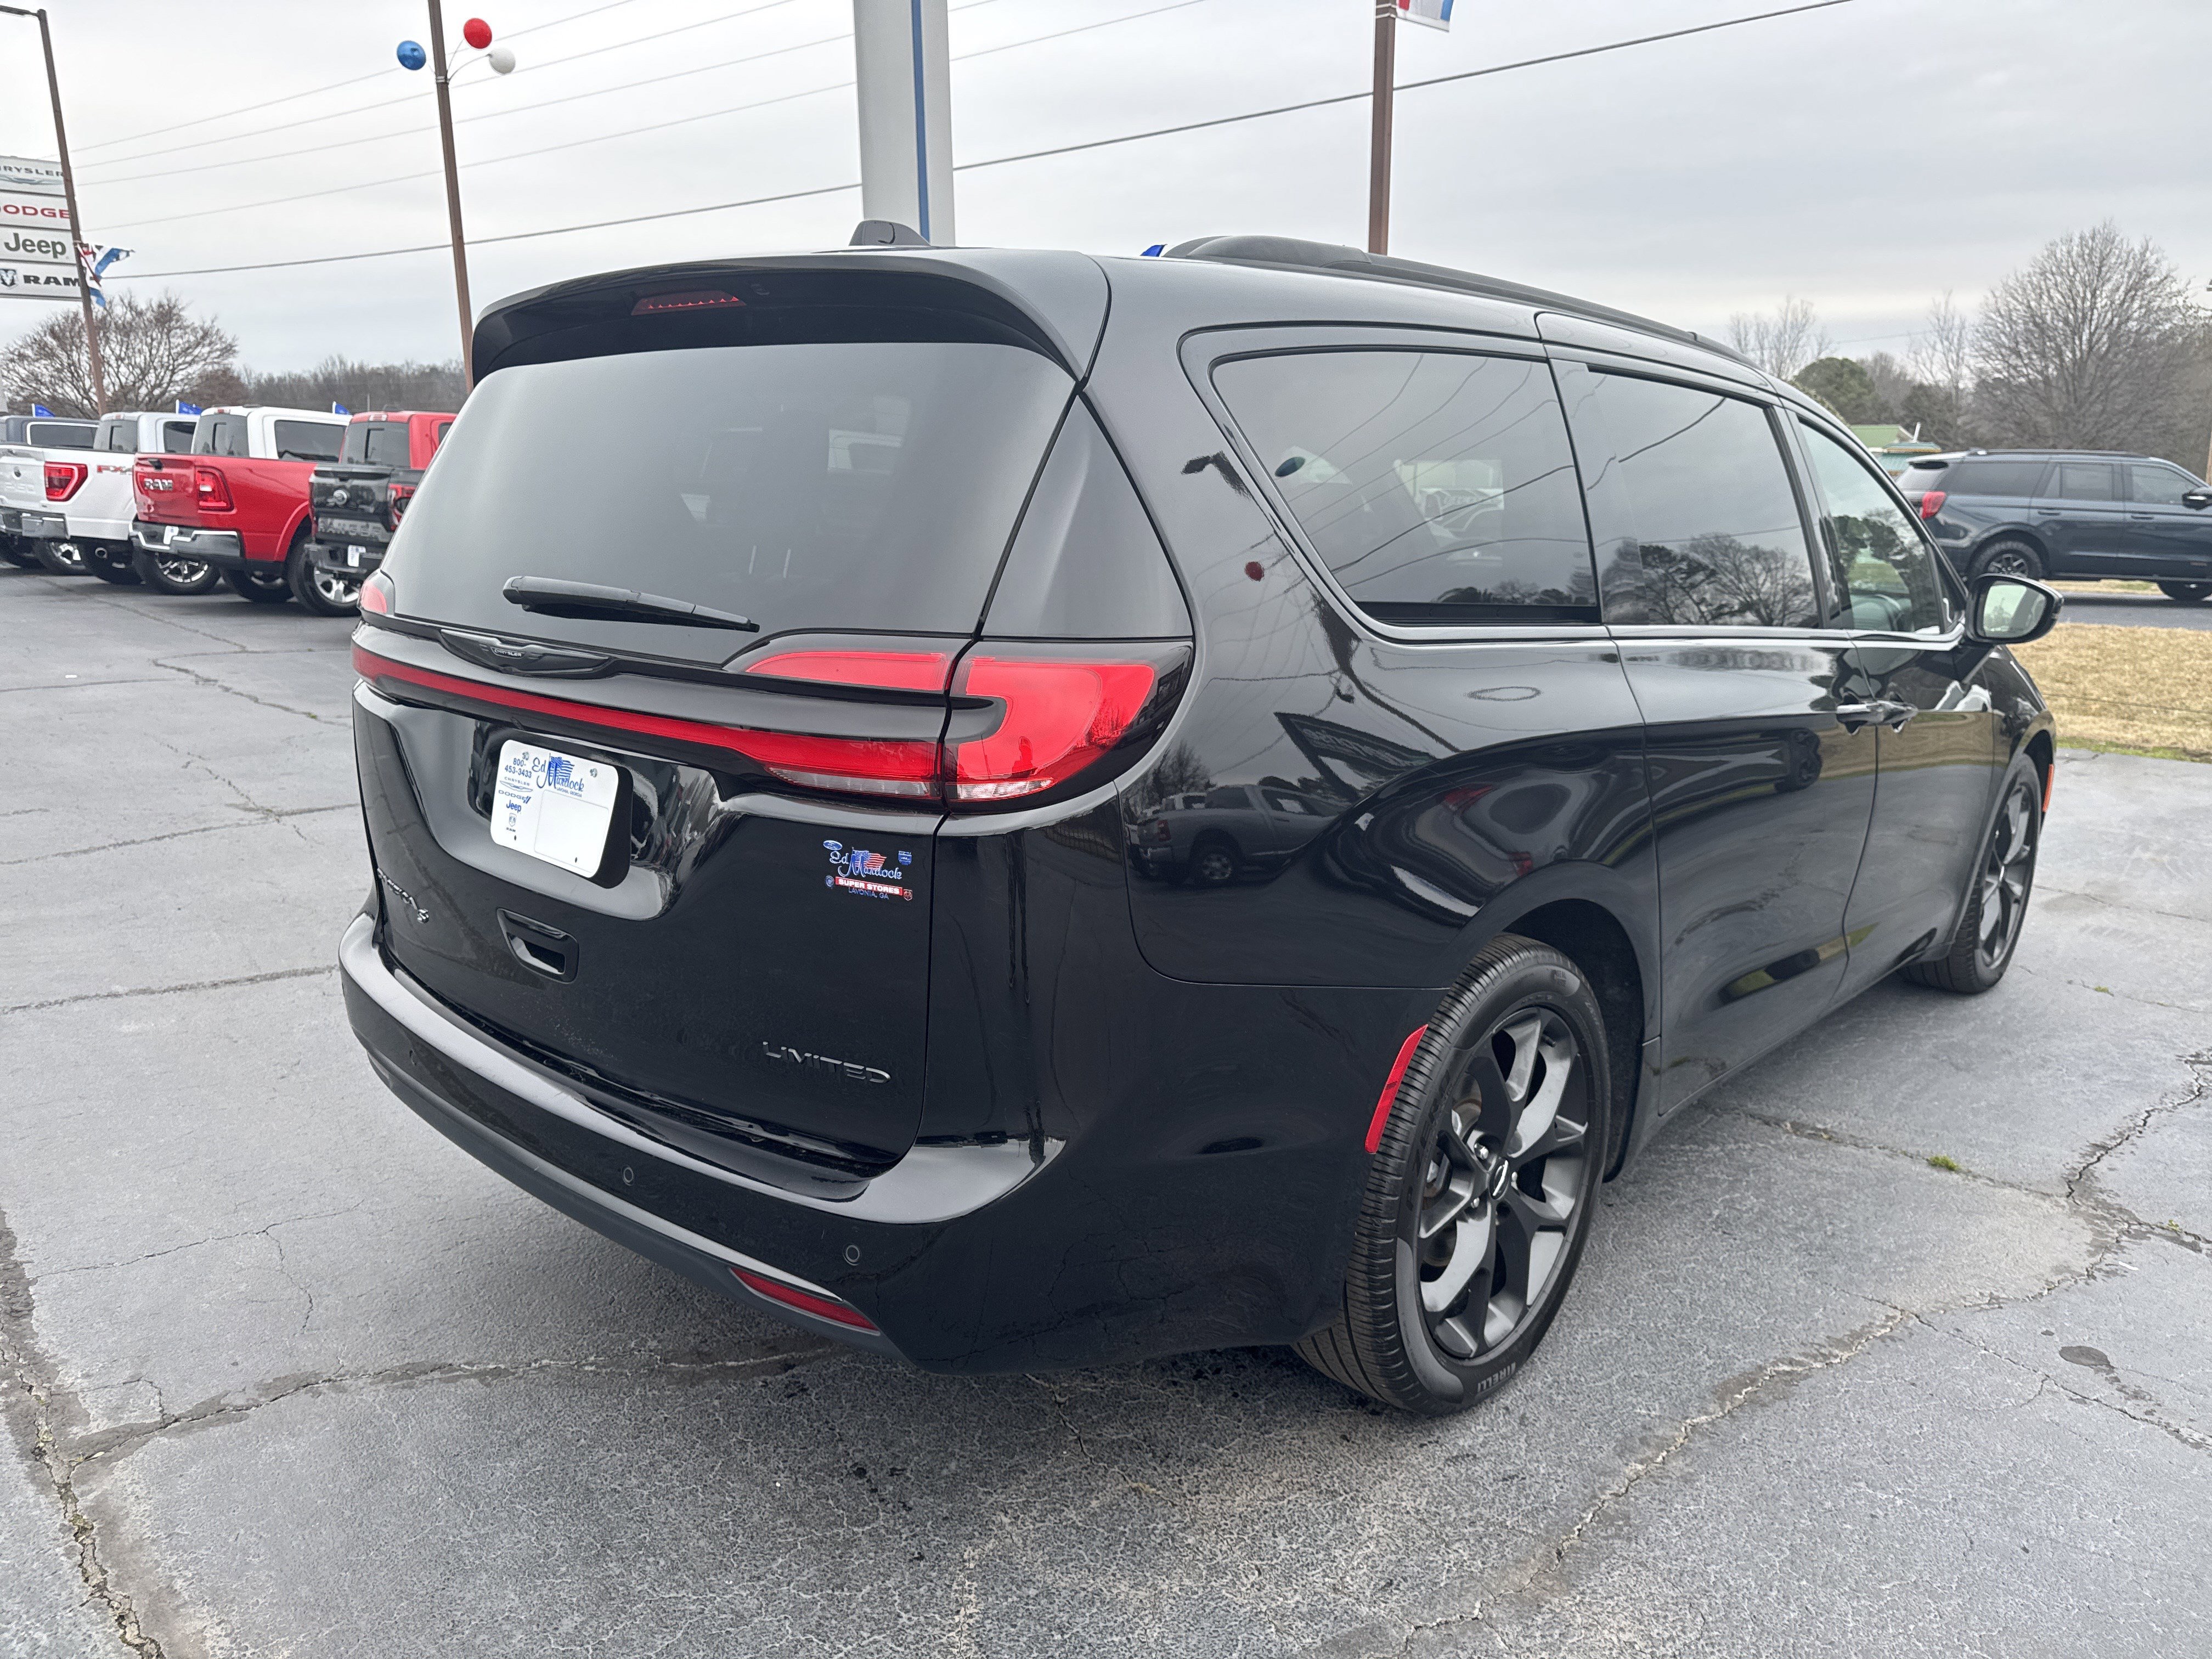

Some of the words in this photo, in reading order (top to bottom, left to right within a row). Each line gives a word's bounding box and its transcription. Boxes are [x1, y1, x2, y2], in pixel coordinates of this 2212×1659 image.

[0, 166, 64, 177] RYSLER
[0, 205, 70, 219] ODGE
[4, 233, 66, 259] Jeep
[23, 275, 81, 286] RAM
[504, 765, 532, 778] 453-3433
[532, 757, 546, 773] Ed
[506, 799, 522, 814] Jeep
[829, 850, 849, 864] Ed
[838, 878, 865, 889] SUPER
[866, 883, 900, 895] STORES
[763, 1041, 891, 1084] LIMITED
[1477, 1361, 1516, 1393] PIRELLI
